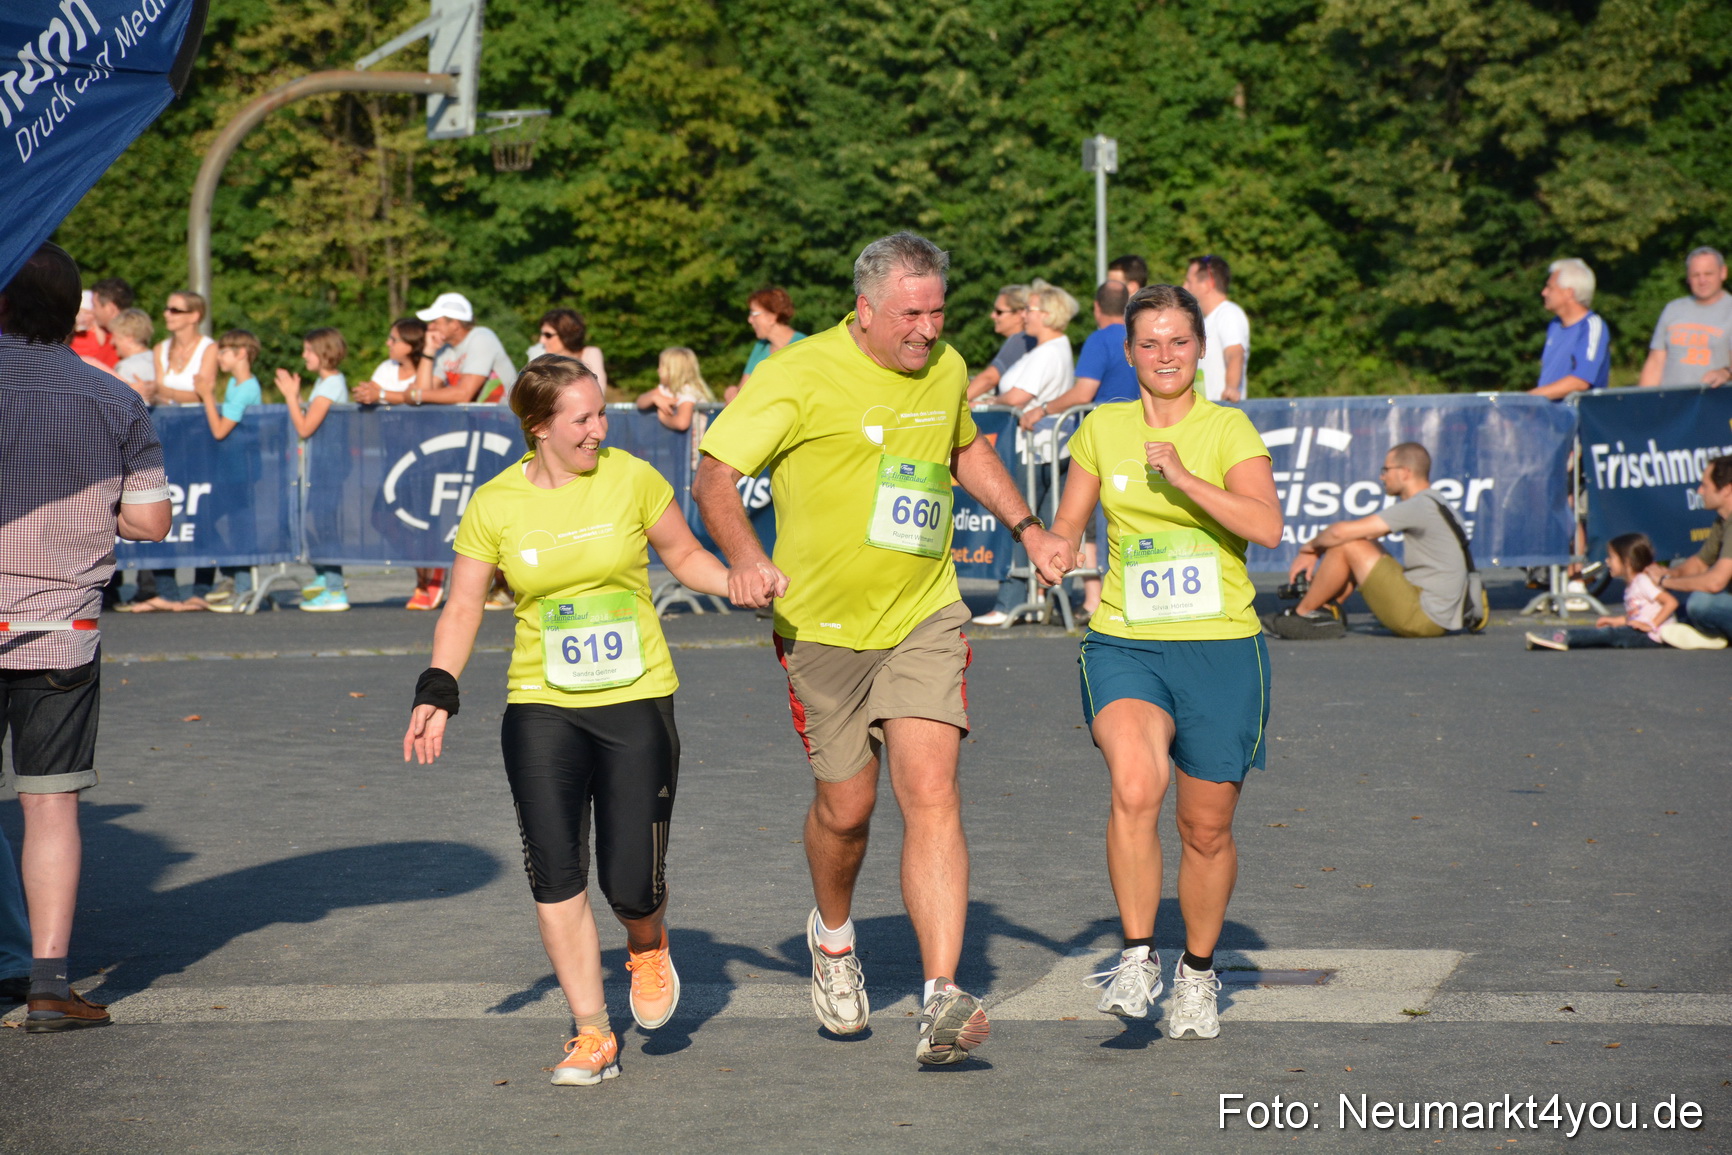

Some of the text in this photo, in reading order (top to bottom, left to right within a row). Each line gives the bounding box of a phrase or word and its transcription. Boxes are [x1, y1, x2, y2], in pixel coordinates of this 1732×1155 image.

[15, 82, 76, 163] Druck
[1591, 439, 1732, 489] Frischma
[430, 473, 475, 516] Fi
[892, 495, 941, 530] 660
[1272, 472, 1495, 516] iscer
[952, 507, 996, 532] dien
[1141, 566, 1202, 598] 618
[562, 631, 623, 664] 619
